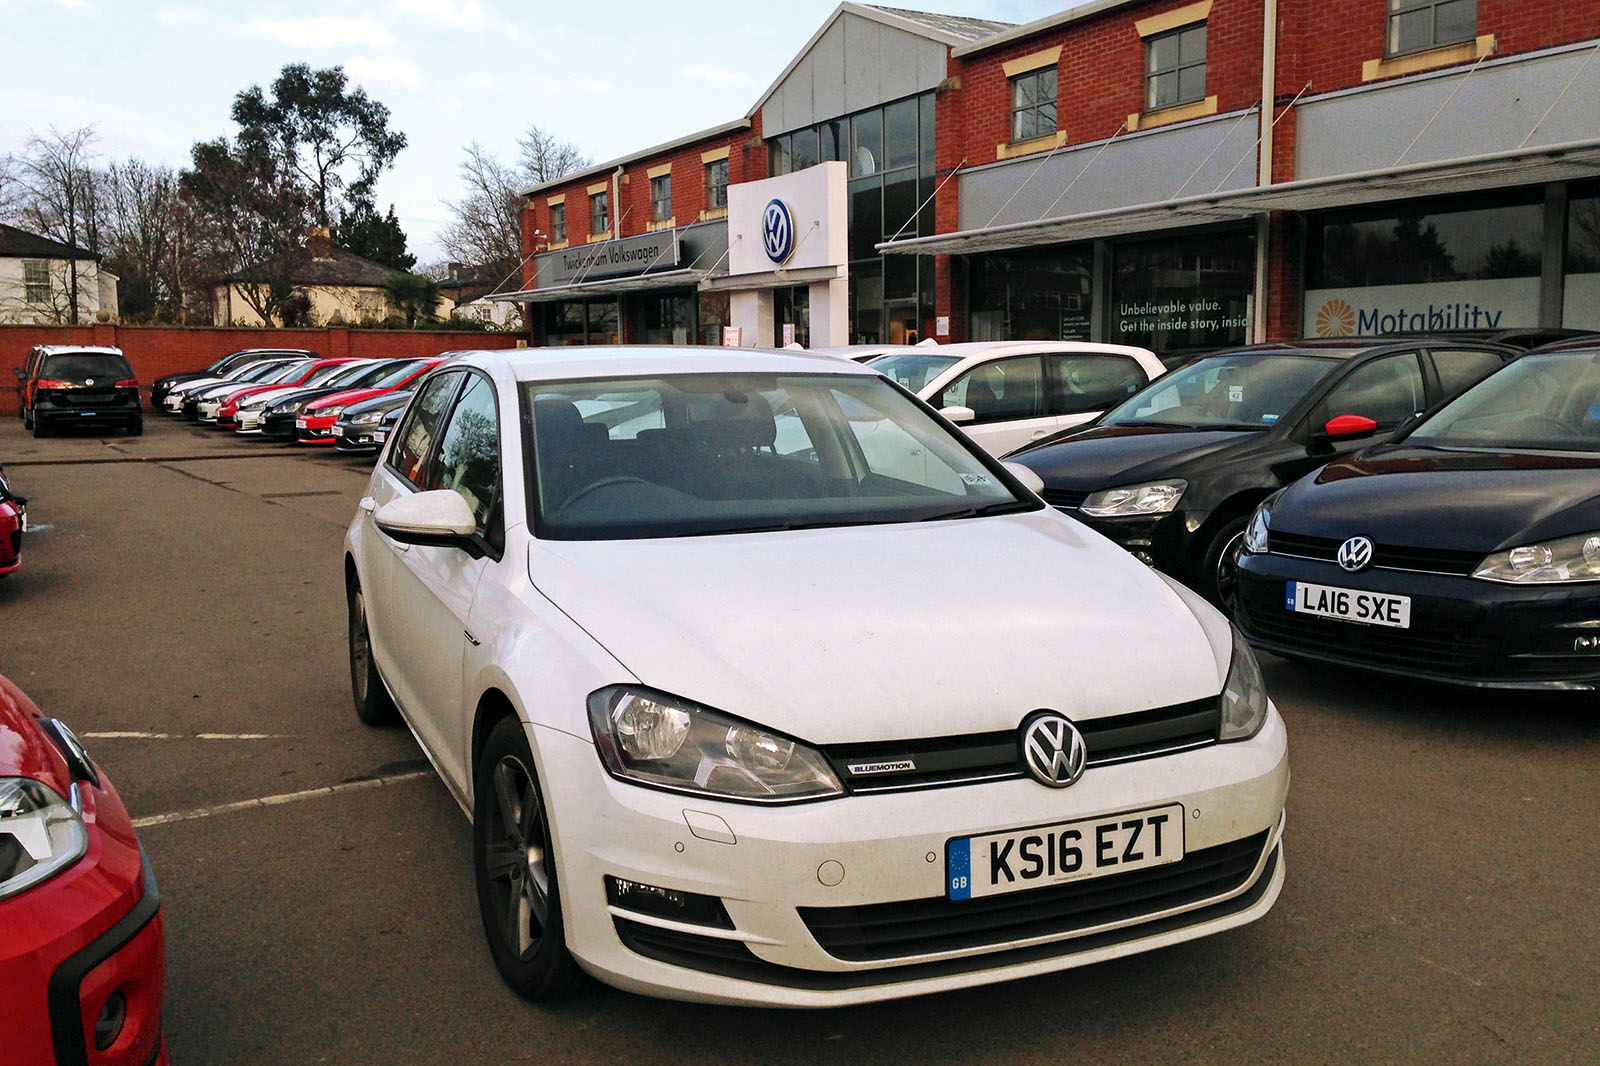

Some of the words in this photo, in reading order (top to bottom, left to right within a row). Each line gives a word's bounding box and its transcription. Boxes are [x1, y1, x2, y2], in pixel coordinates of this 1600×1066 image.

[563, 253, 608, 271] Twickenham
[608, 245, 659, 264] Volkswagen
[1120, 299, 1186, 316] Unbelievable
[1188, 298, 1222, 312] value.
[1120, 320, 1138, 332] Get
[1139, 319, 1155, 331] the
[1157, 317, 1188, 330] inside
[1190, 318, 1219, 331] story,
[1358, 304, 1503, 336] Motability
[1303, 587, 1350, 615] LA16
[1356, 595, 1402, 623] SXE
[854, 762, 911, 773] BLUEMOTION
[990, 829, 1083, 885] KS16
[1096, 814, 1169, 868] EZT
[952, 876, 968, 889] GB
